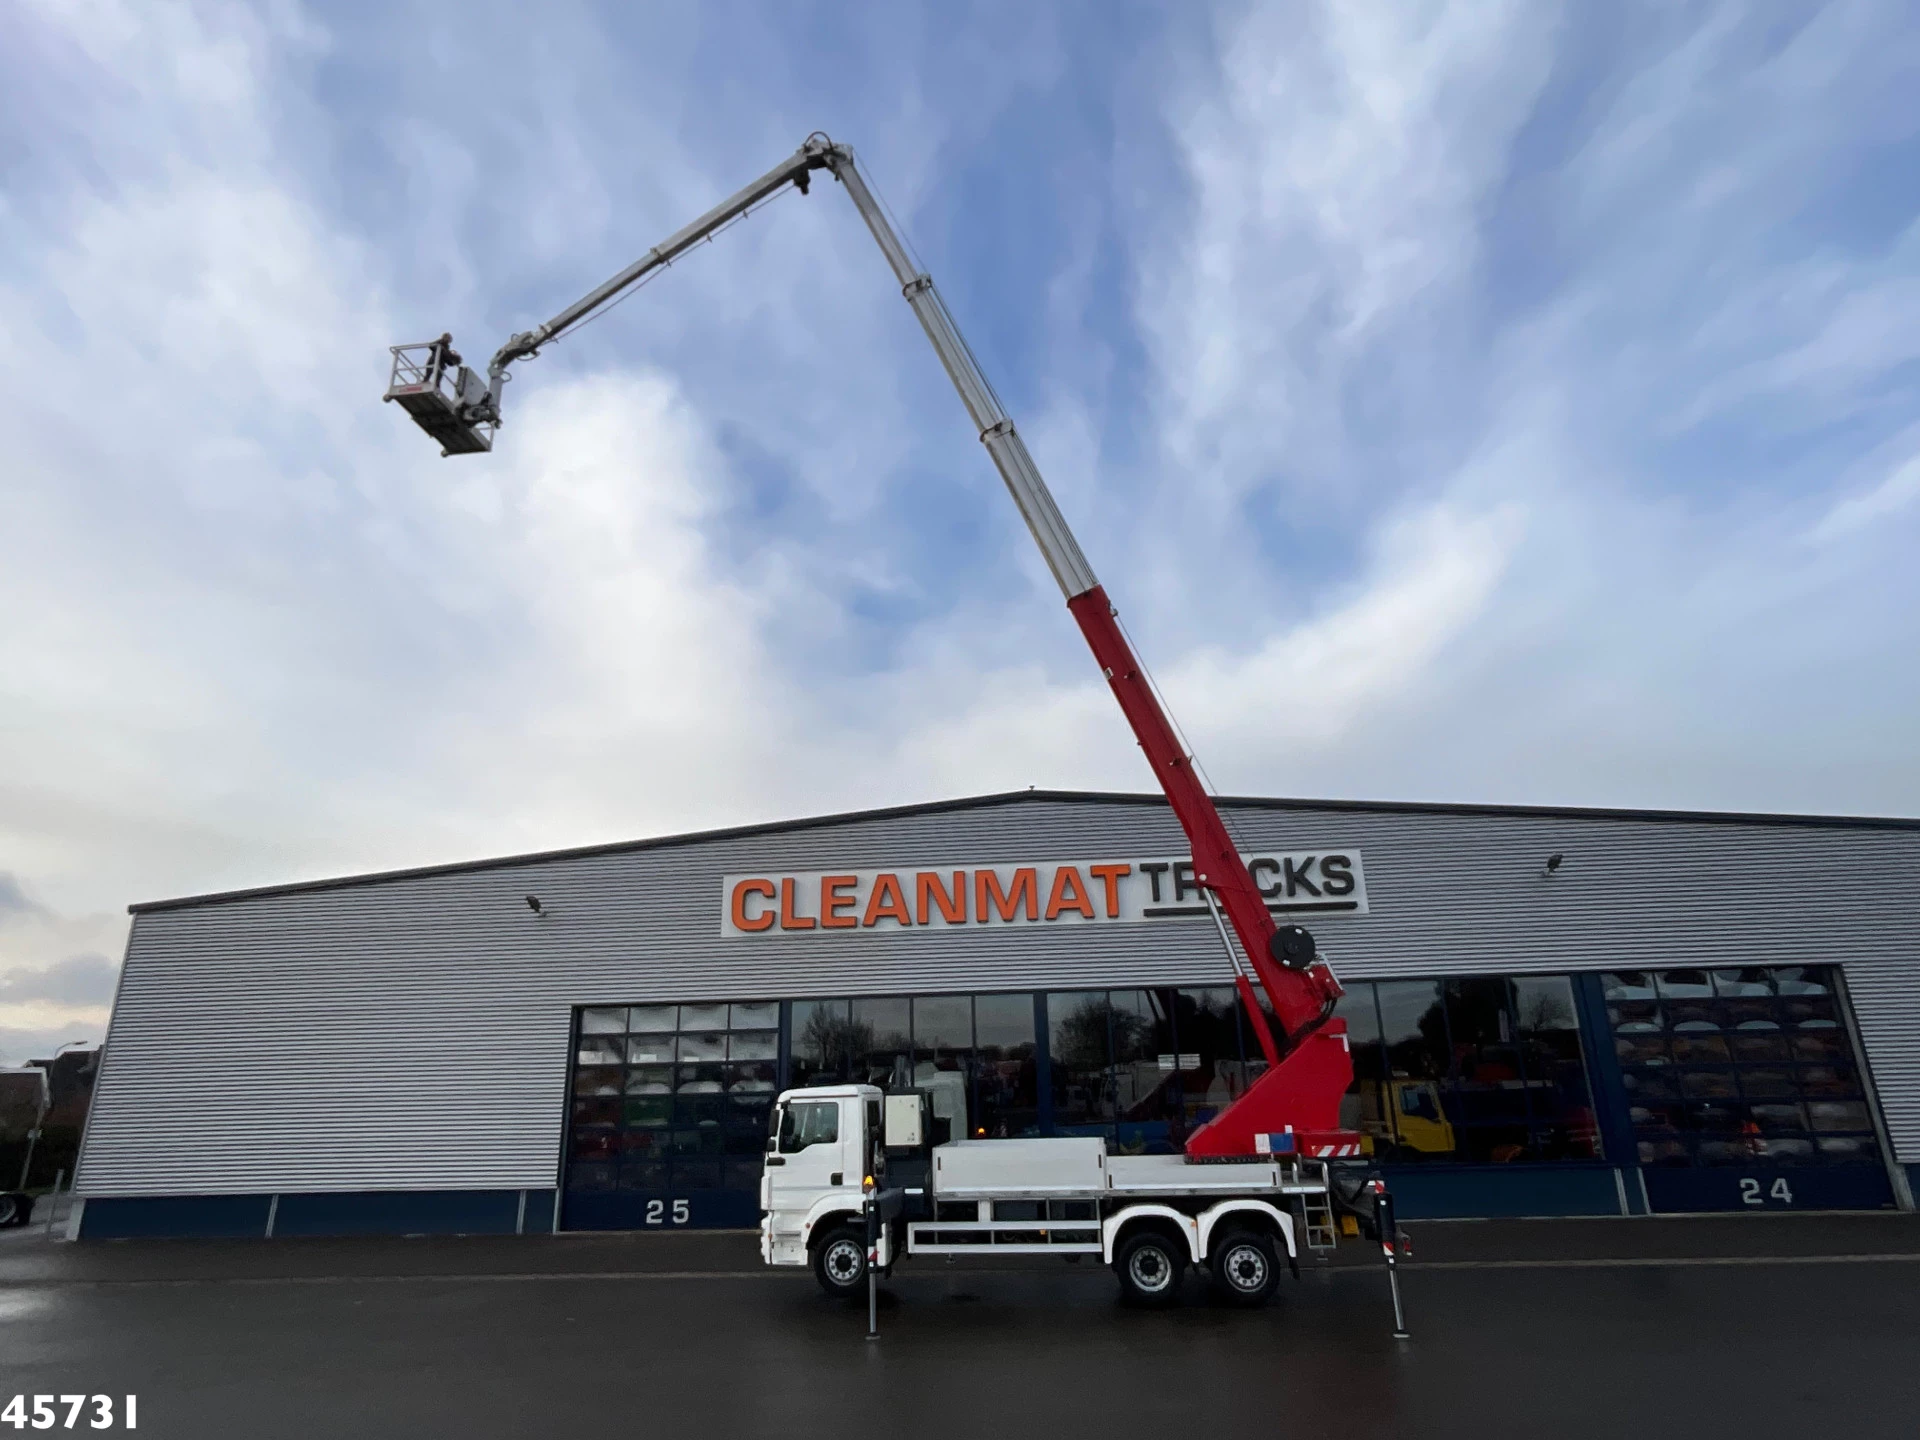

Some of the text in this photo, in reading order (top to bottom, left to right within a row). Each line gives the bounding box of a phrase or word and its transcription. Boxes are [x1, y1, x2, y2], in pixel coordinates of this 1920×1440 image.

[731, 854, 1356, 932] CLEANMAT TRCKS
[1739, 1177, 1793, 1204] 24
[645, 1199, 690, 1224] 25
